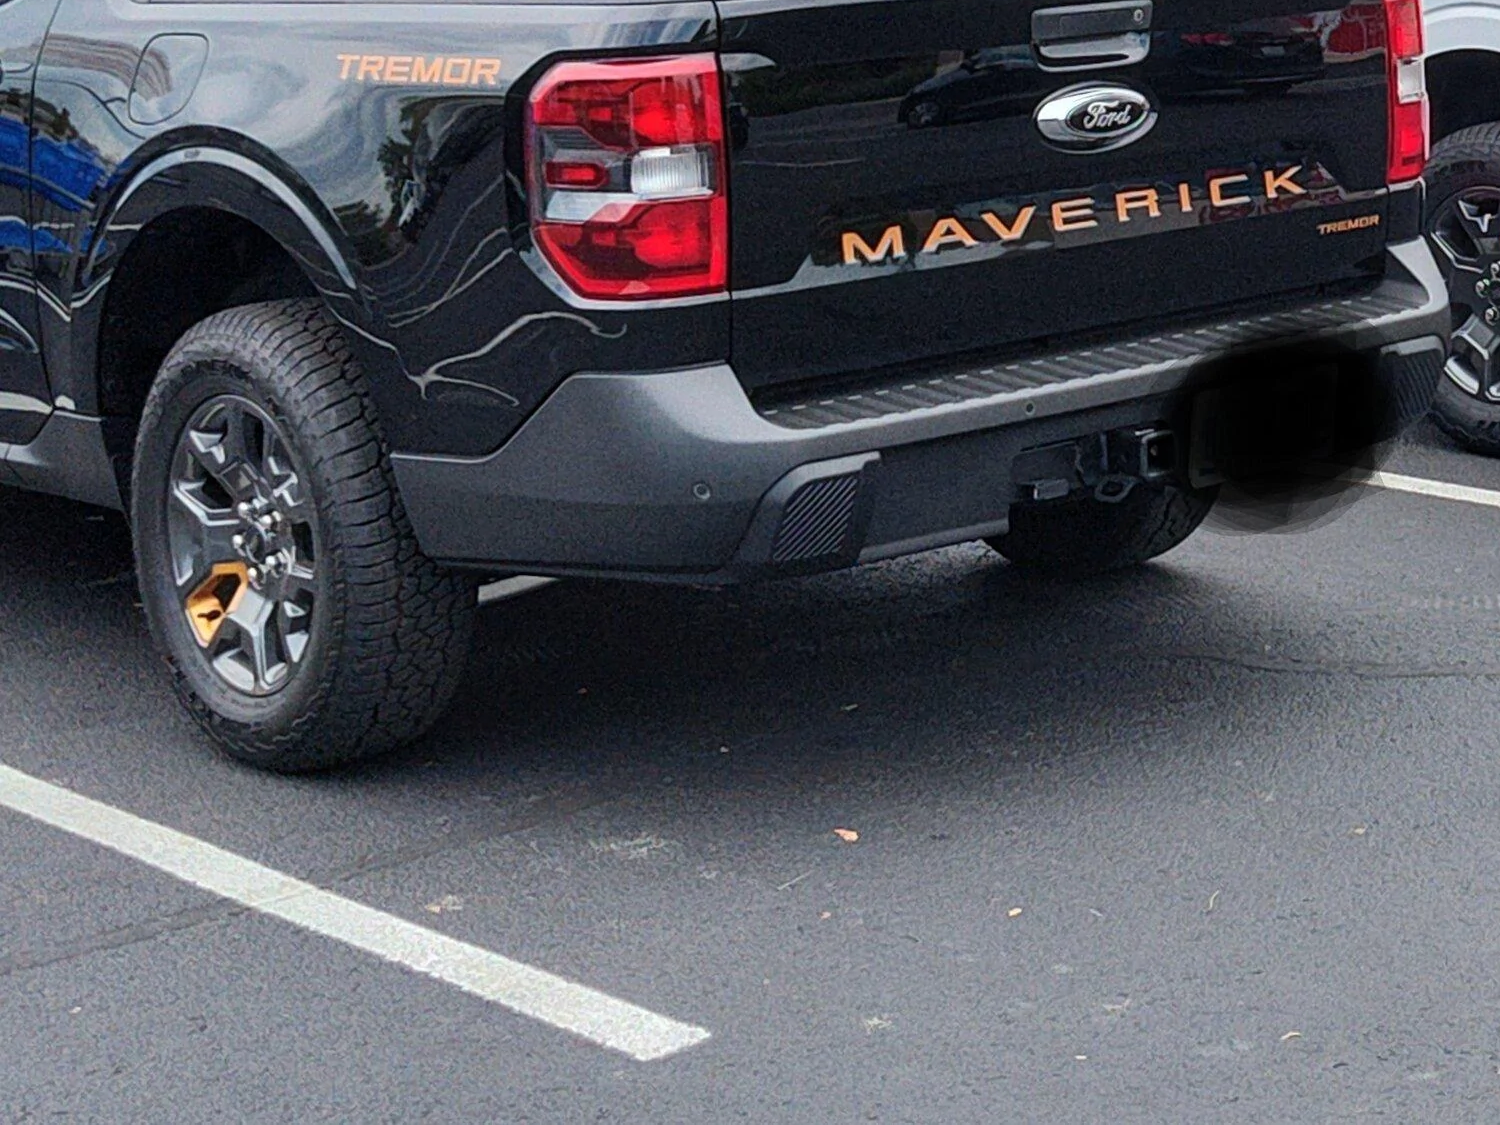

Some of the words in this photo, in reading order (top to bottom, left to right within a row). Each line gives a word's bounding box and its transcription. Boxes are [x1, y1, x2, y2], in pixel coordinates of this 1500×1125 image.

[336, 53, 502, 85] TREMOR
[1082, 99, 1132, 129] Ford
[841, 166, 1307, 265] MAVERICK
[1316, 214, 1380, 235] TREMOR
